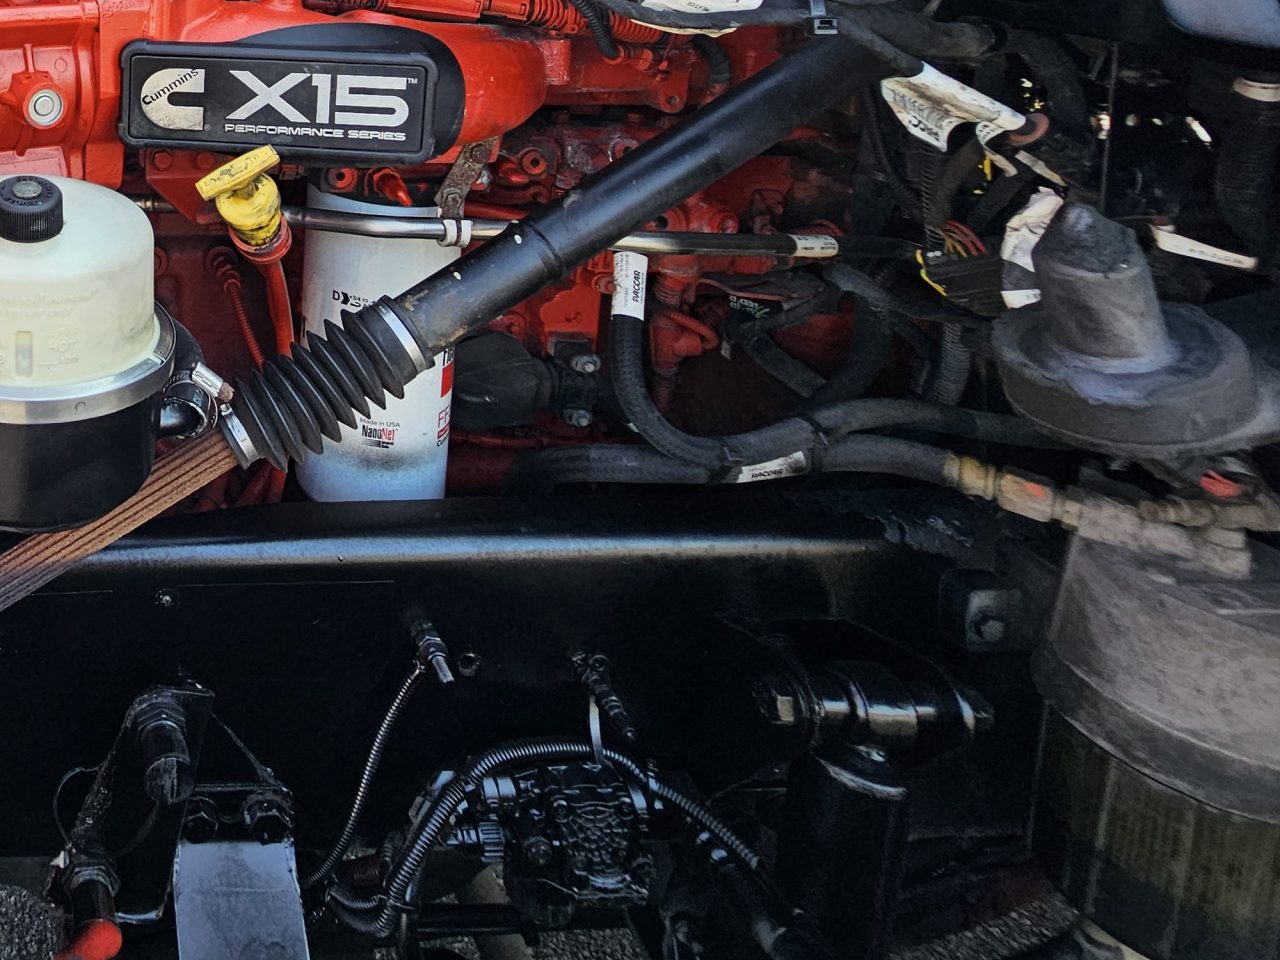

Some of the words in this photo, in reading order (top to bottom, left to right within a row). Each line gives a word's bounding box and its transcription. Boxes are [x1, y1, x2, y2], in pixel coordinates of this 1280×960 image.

[141, 68, 199, 106] Cummins
[224, 69, 411, 128] X15
[224, 123, 345, 139] PERFORMANCE
[347, 129, 407, 142] SERIES
[631, 270, 641, 303] PACCAR
[361, 424, 395, 441] NanoNet
[385, 420, 400, 428] USA
